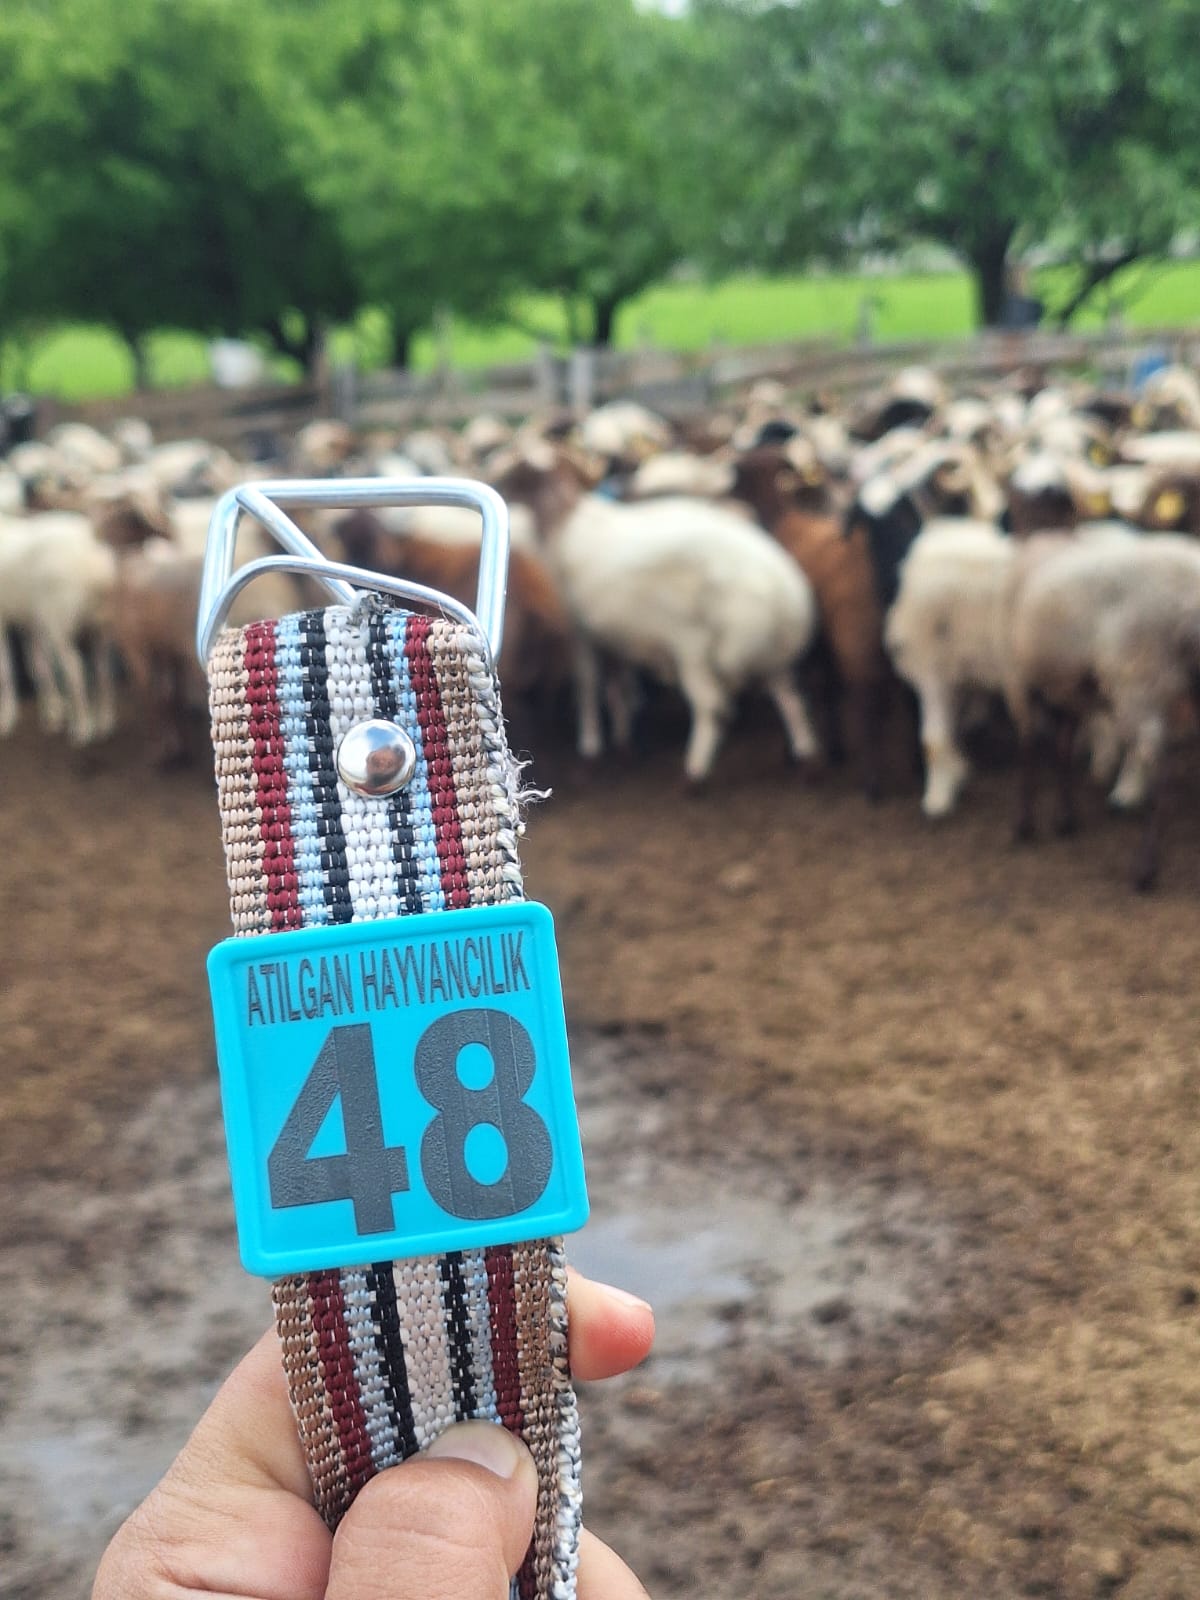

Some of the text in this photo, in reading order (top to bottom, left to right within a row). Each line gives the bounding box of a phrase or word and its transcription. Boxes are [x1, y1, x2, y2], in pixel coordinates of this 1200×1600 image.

[248, 931, 531, 1026] ATILGAN HAYVANCILIK
[267, 1008, 553, 1236] 48
